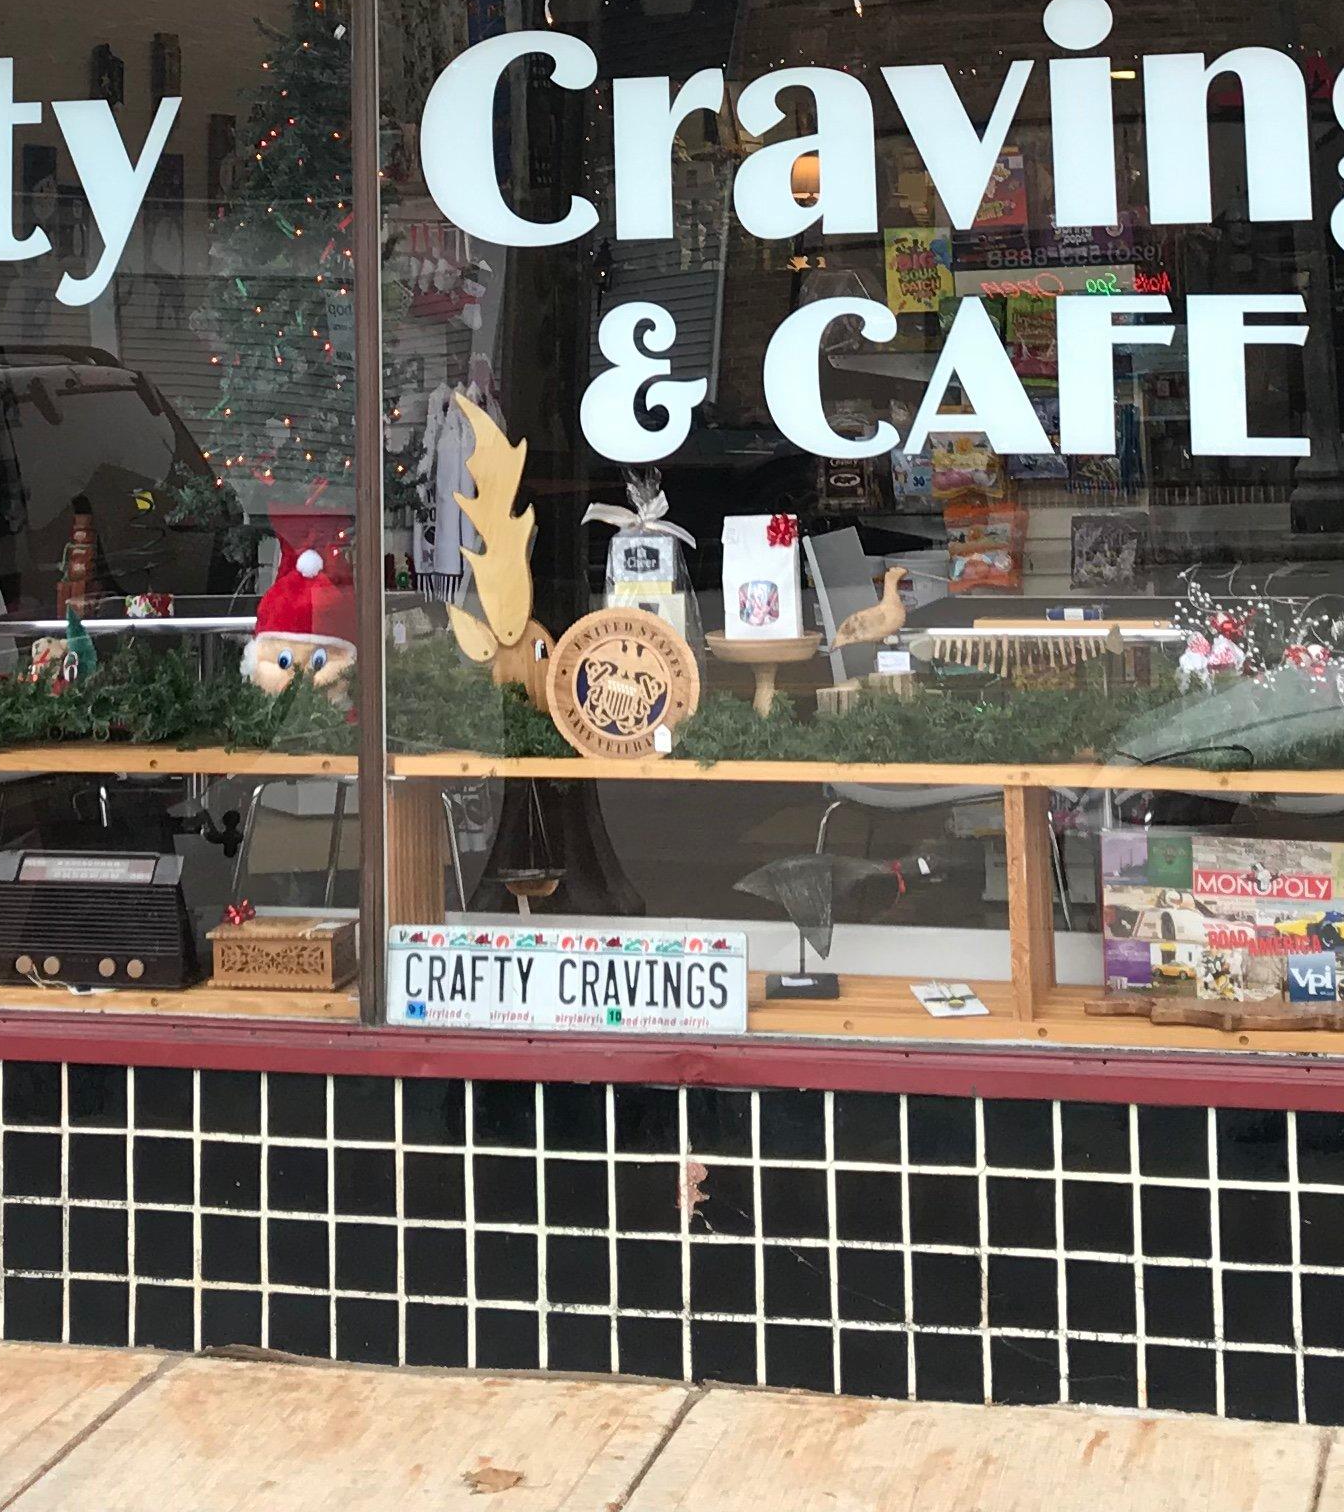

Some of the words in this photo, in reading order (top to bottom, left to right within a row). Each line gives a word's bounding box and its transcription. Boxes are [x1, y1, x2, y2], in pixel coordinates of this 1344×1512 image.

[901, 268, 937, 281] SOUR
[580, 302, 708, 463] &
[763, 293, 1311, 460] CAFE
[405, 952, 534, 1003] CRAFTY
[558, 958, 728, 1010] CRAVINGS
[1289, 966, 1334, 995] Vpi
